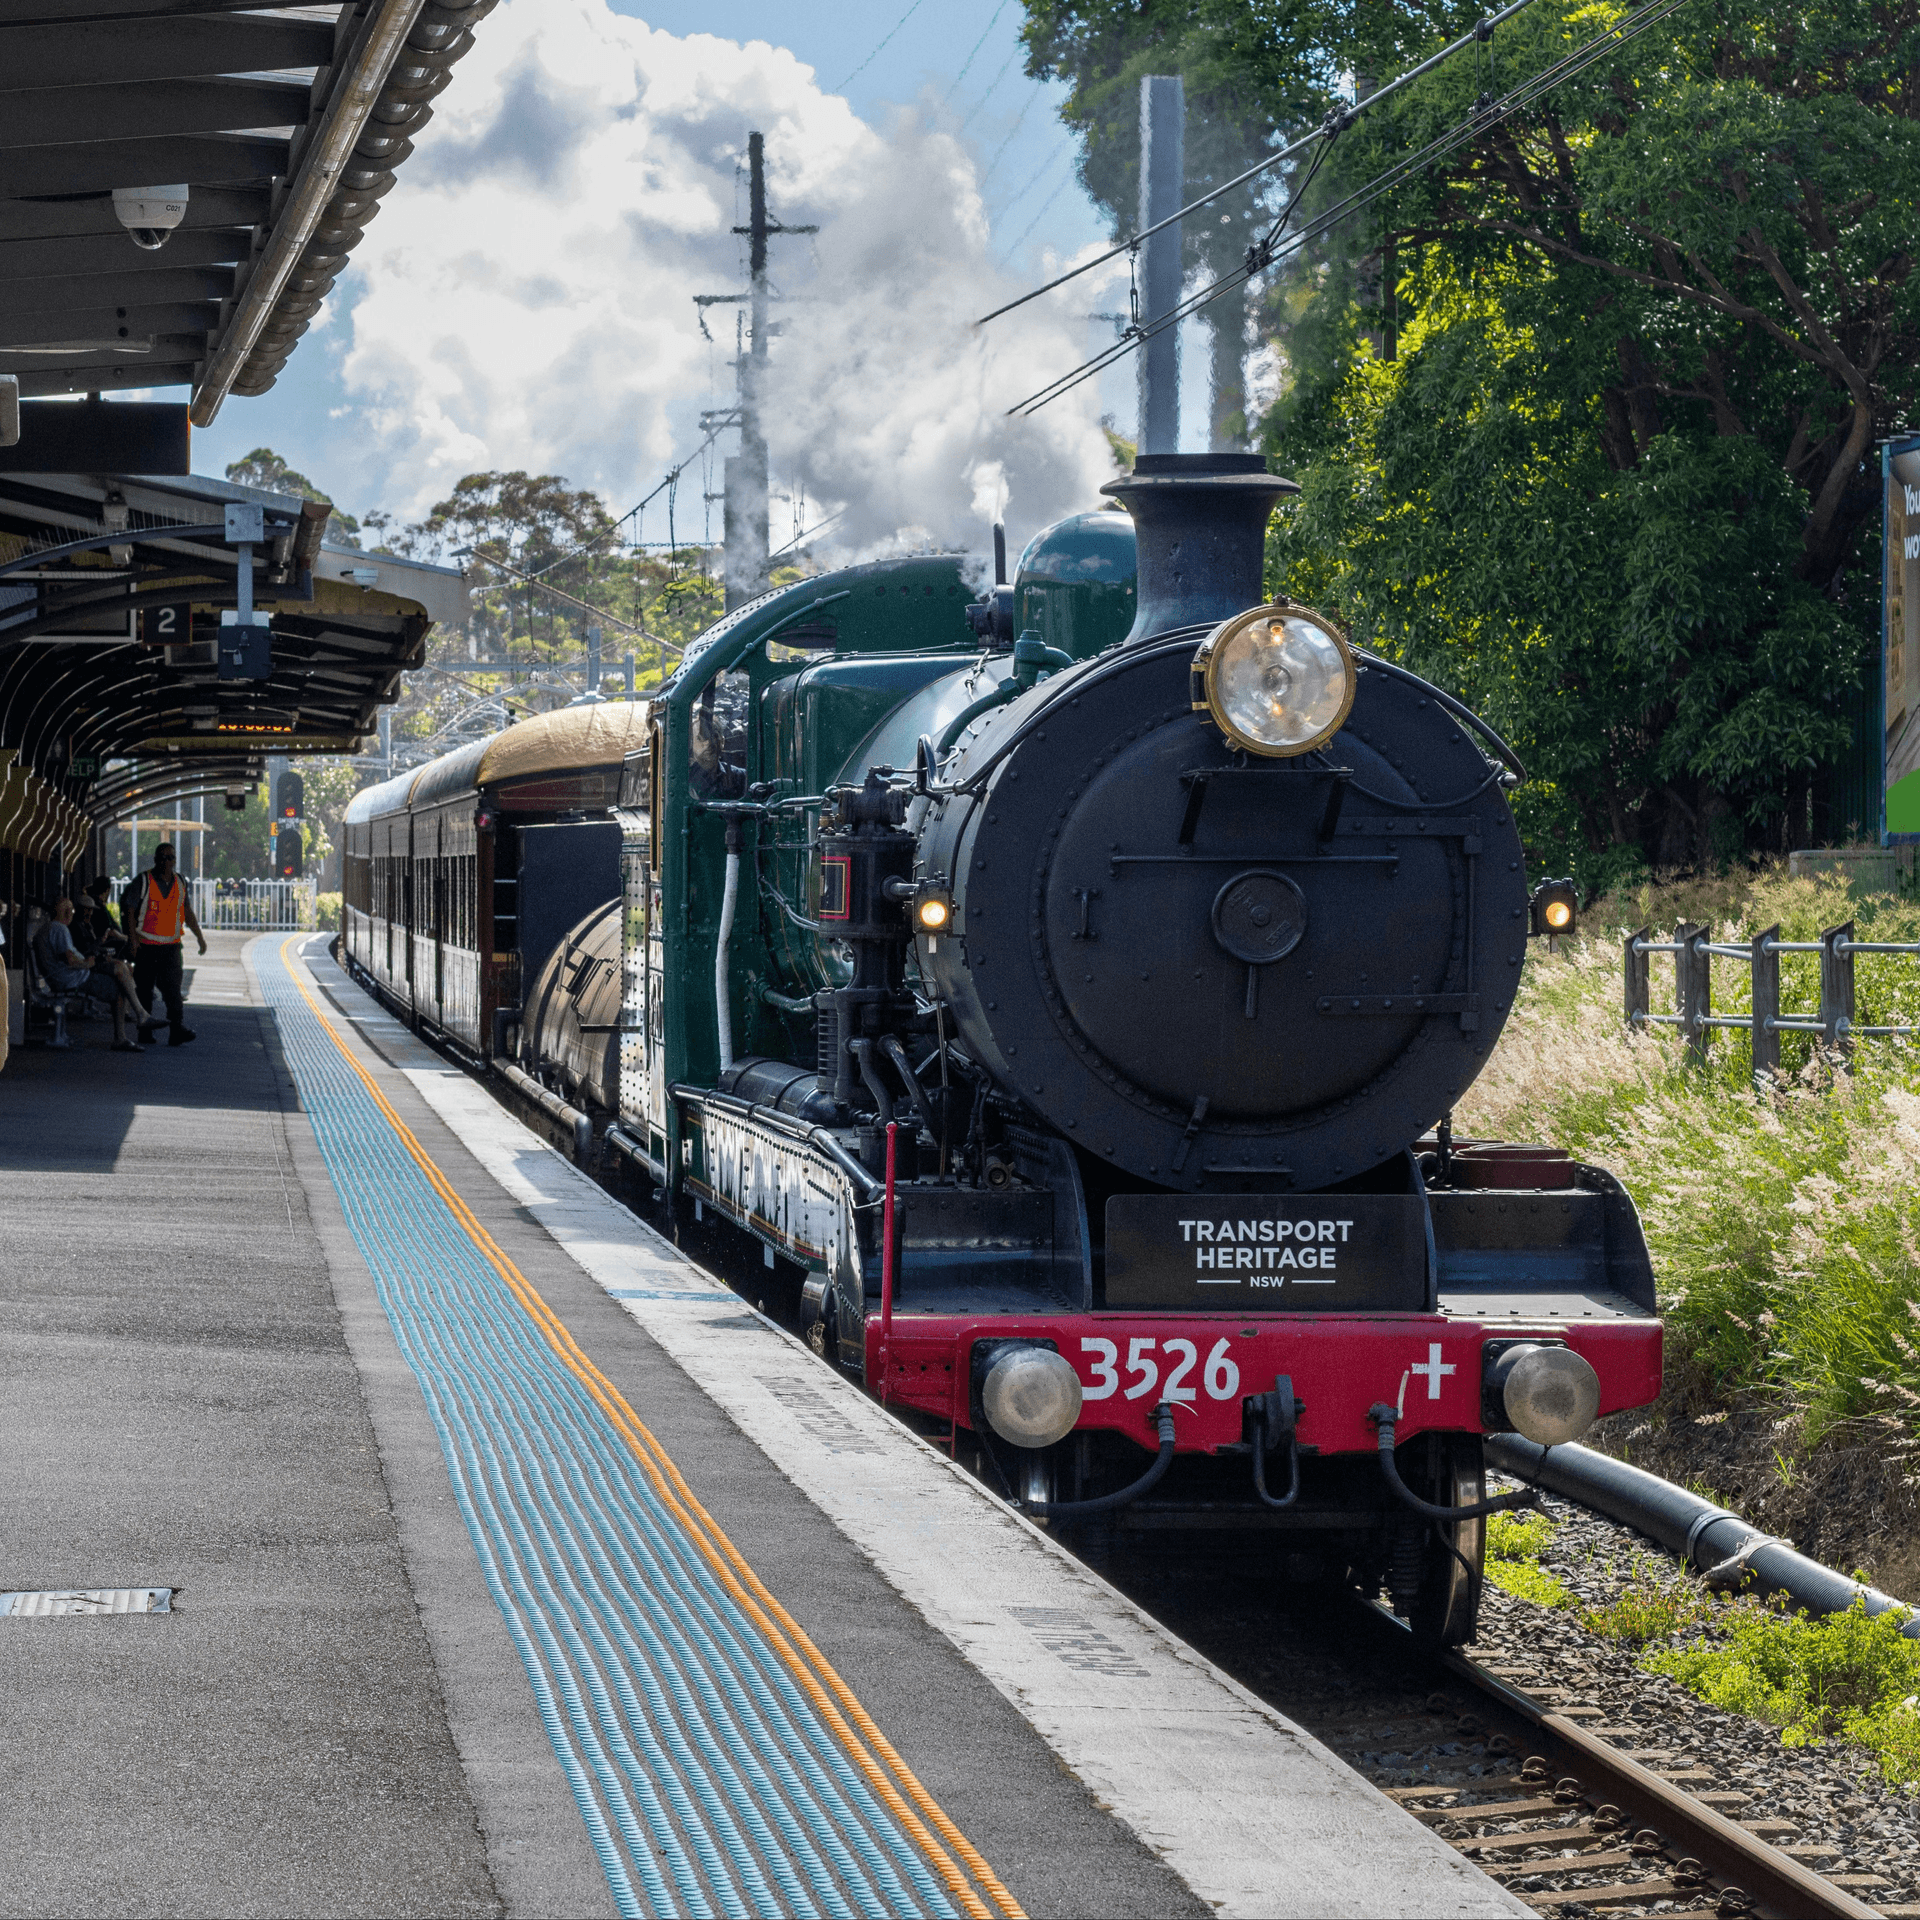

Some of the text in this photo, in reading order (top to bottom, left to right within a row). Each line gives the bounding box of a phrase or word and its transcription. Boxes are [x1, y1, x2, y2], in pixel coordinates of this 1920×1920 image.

[158, 607, 175, 633] 2
[1178, 1220, 1354, 1242] TRANSPORT
[1196, 1247, 1336, 1269] HERITAGE
[1250, 1276, 1285, 1288] NSW
[1081, 1337, 1240, 1401] 3526
